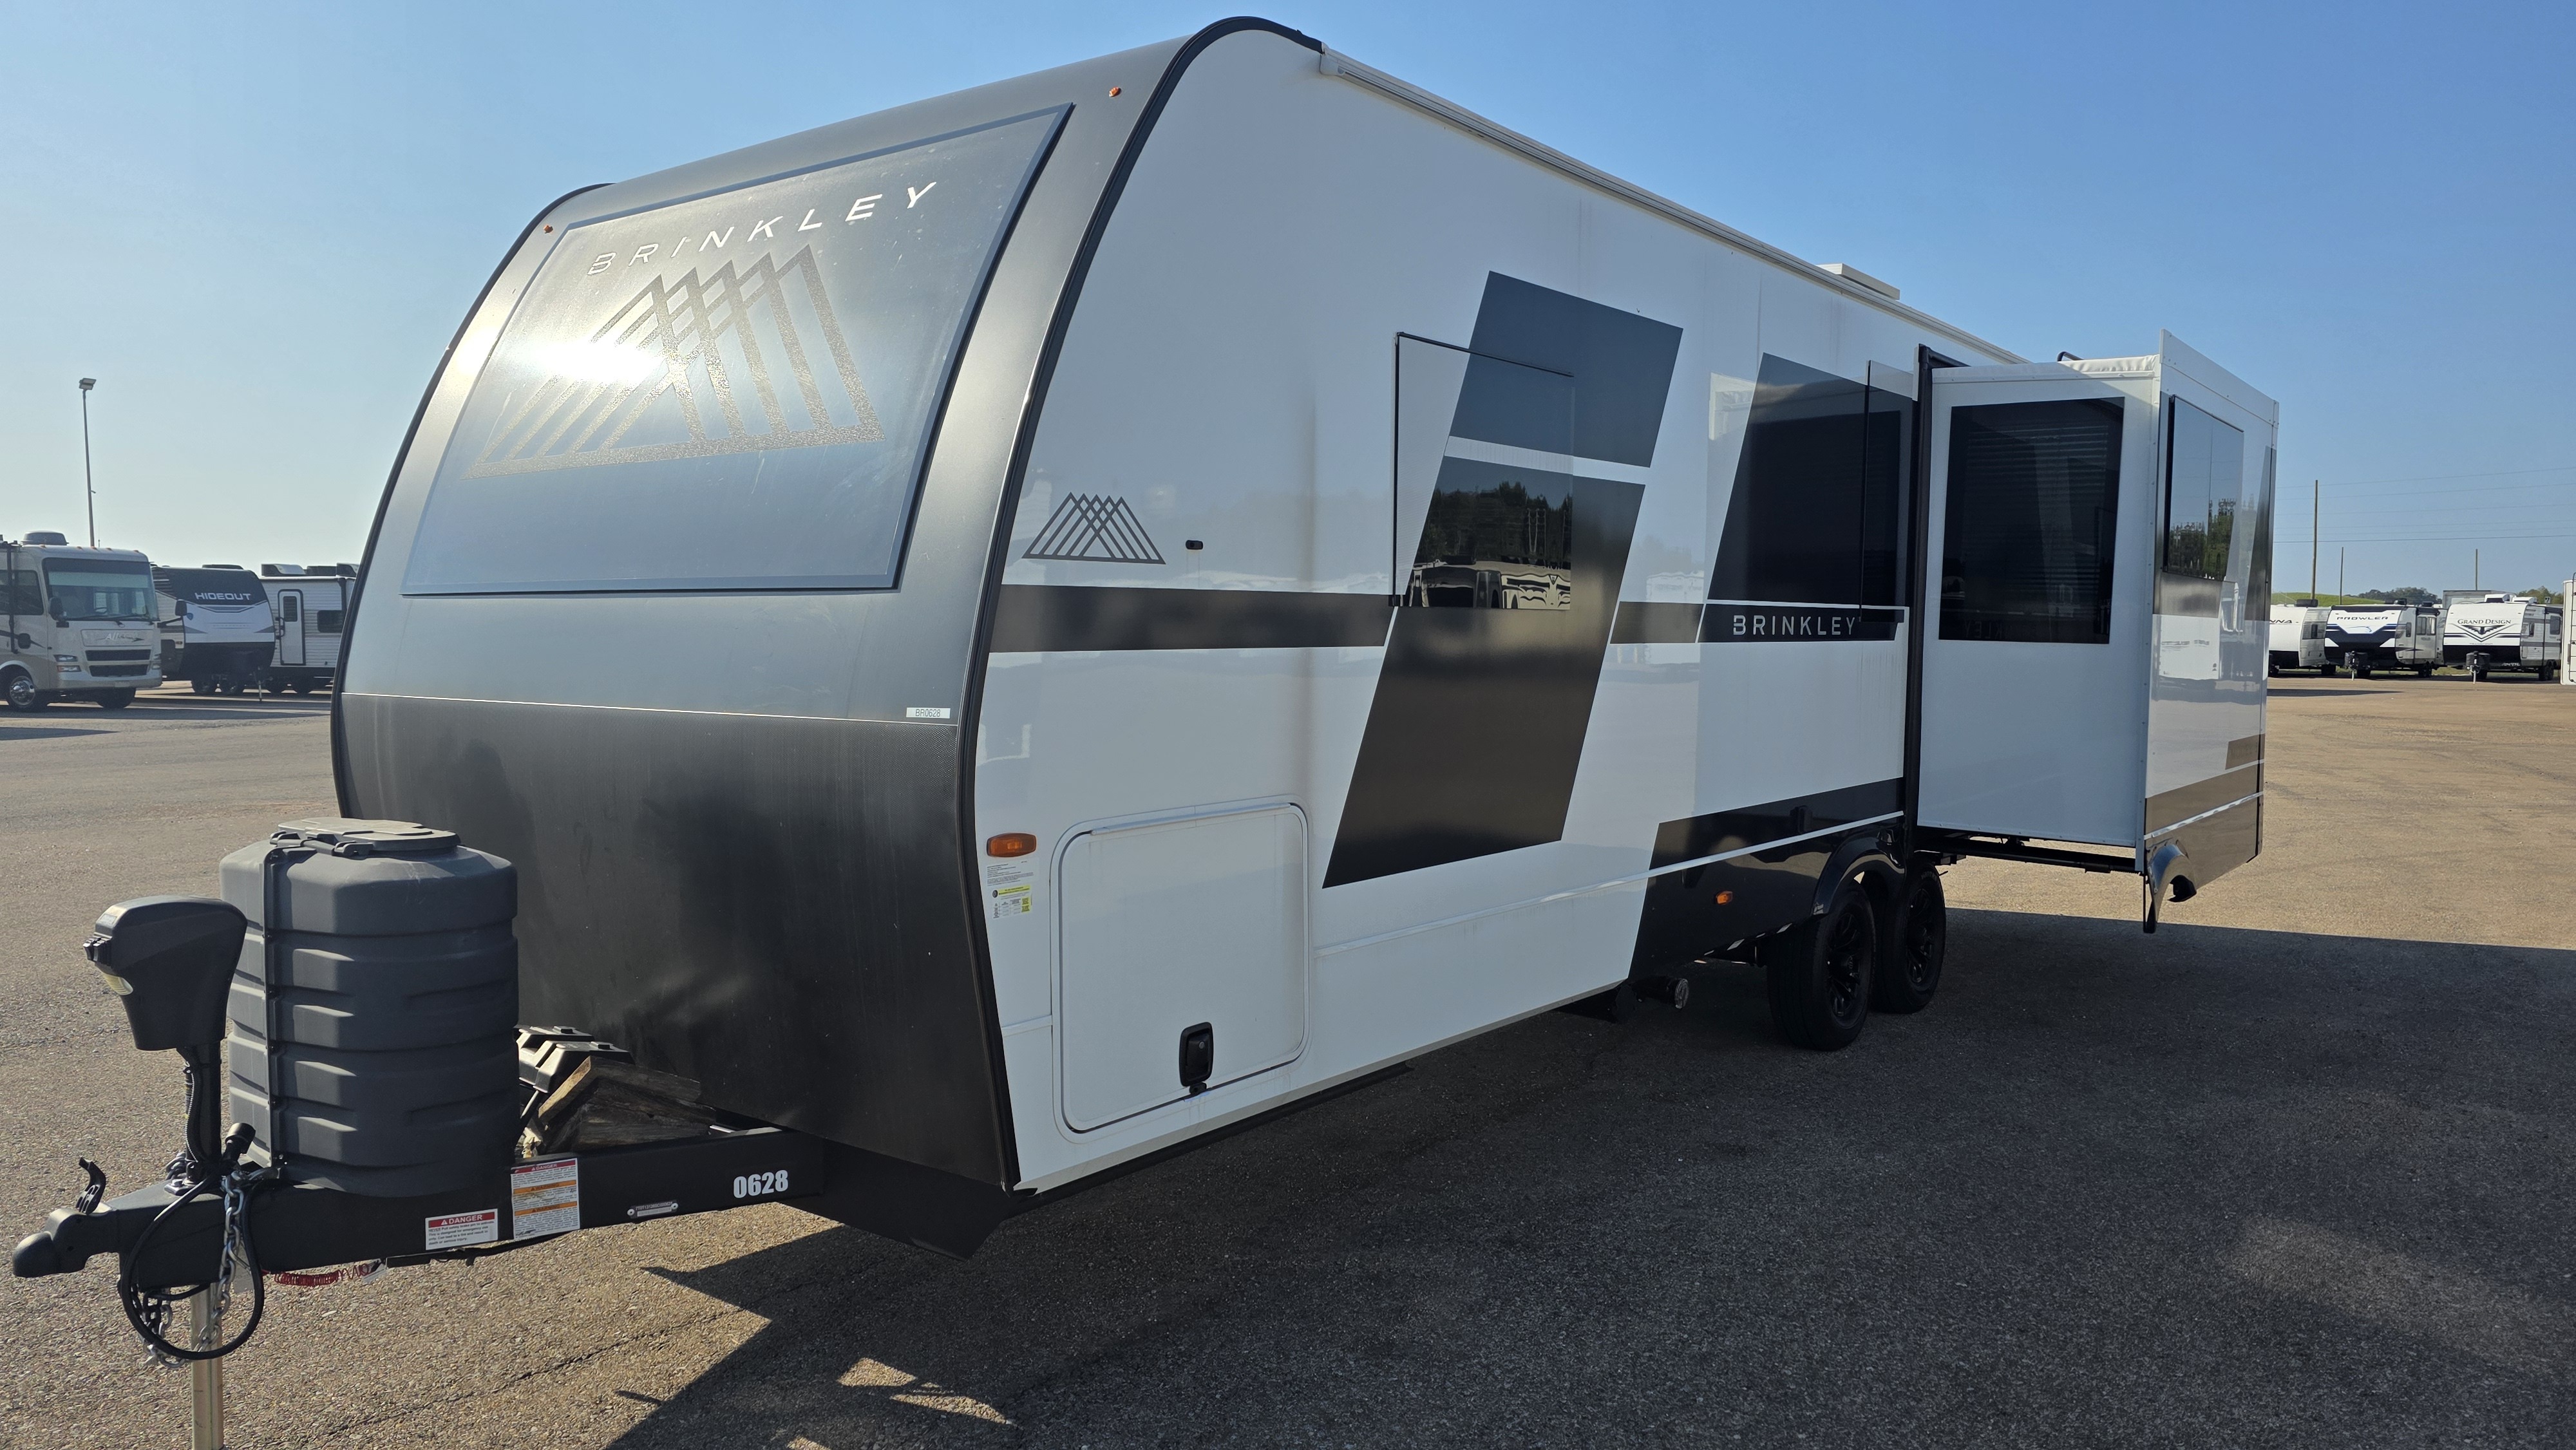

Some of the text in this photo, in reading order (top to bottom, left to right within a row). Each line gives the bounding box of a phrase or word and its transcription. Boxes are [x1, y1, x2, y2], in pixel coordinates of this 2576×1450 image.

[587, 181, 937, 276] BRINKLEY
[194, 592, 251, 601] HIDEOUT
[1733, 615, 1855, 636] BRINKLEY
[915, 708, 941, 717] BR0628
[734, 1169, 788, 1198] 0628
[448, 1214, 483, 1225] DANGER
